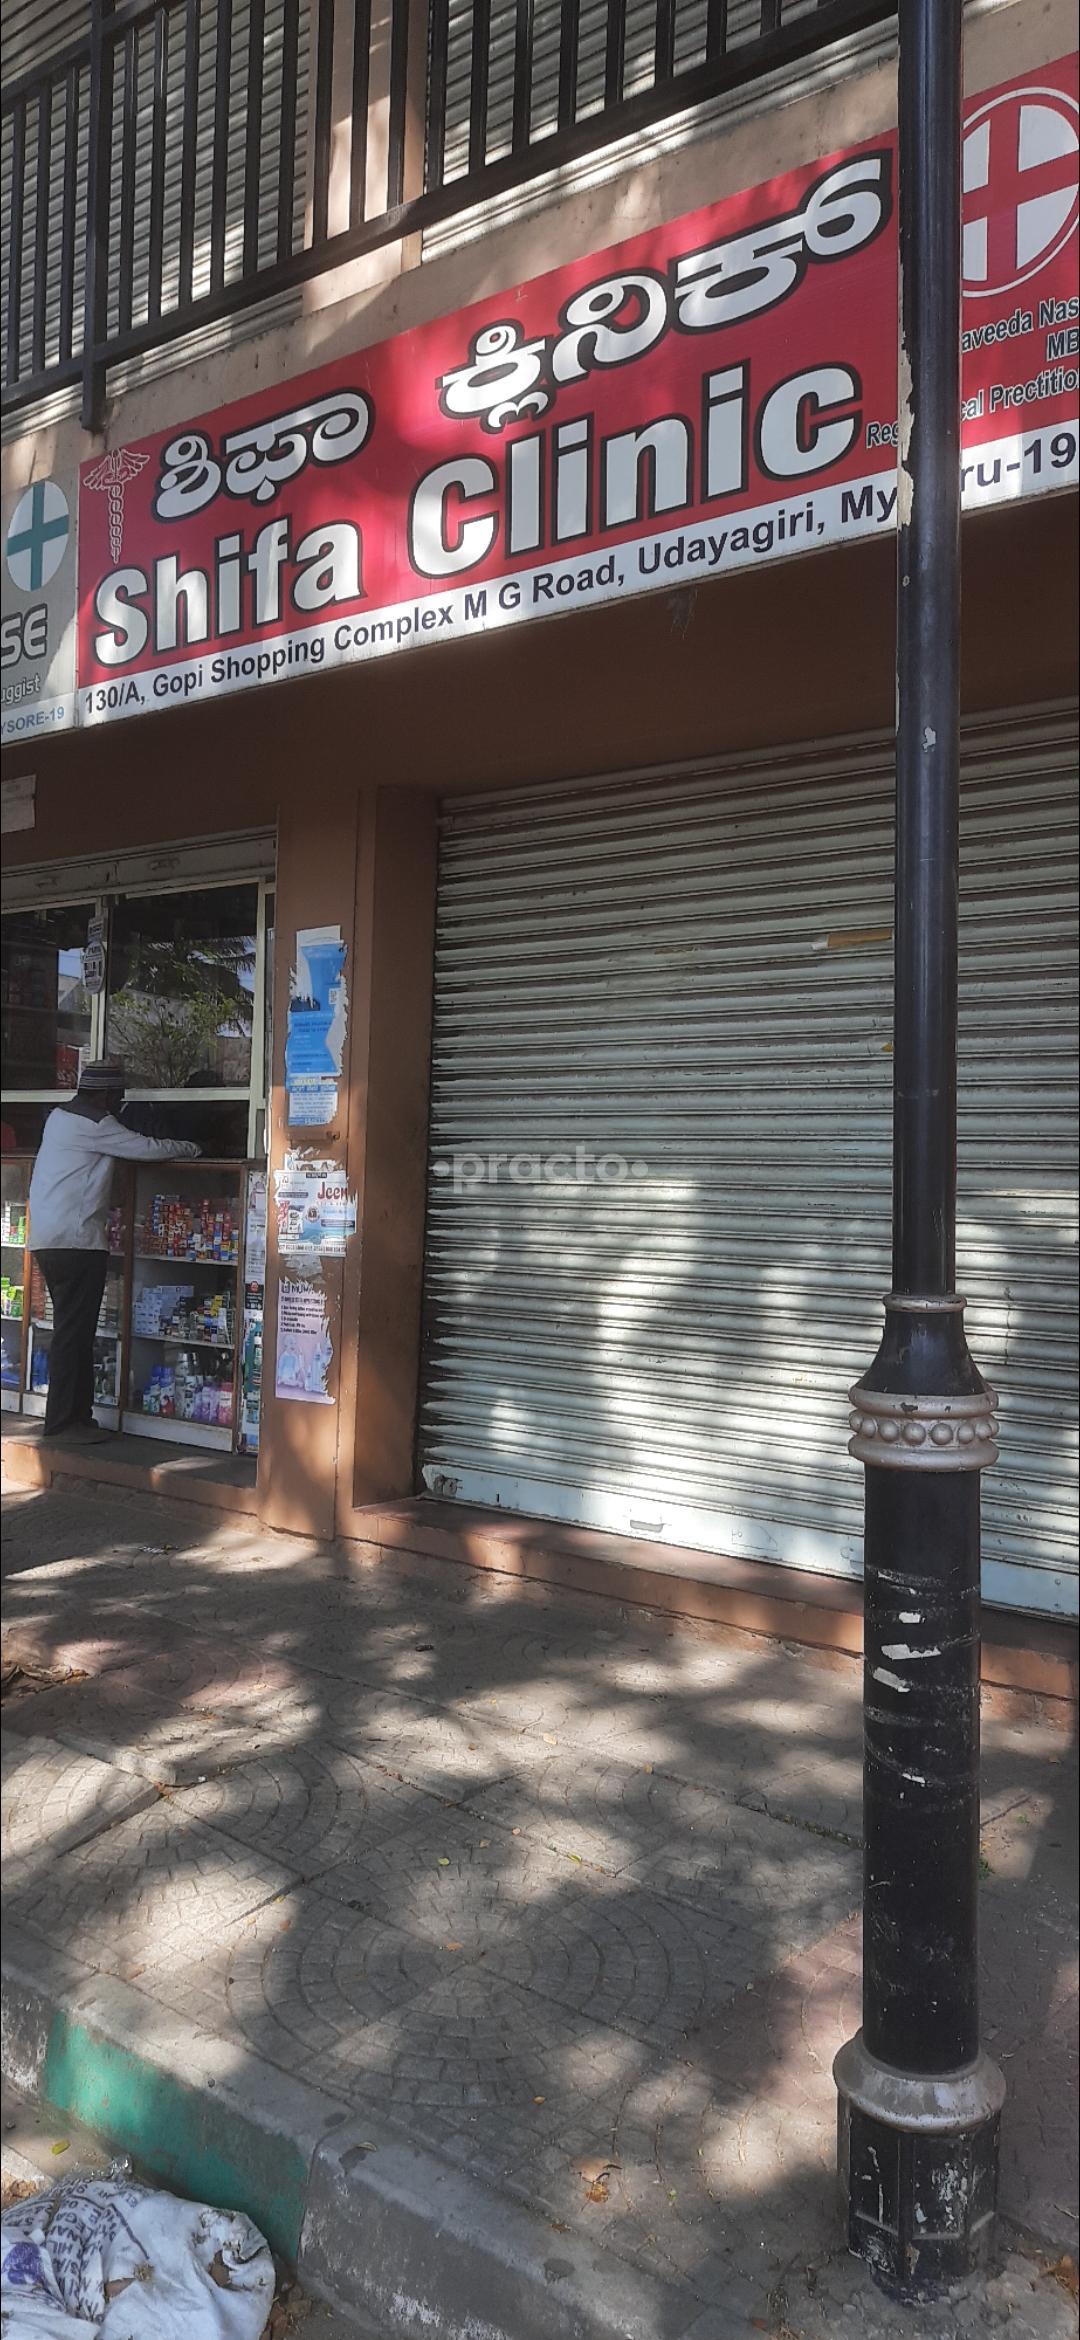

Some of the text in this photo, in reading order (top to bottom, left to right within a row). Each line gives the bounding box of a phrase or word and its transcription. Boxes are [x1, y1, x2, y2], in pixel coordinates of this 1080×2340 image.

[154, 150, 890, 521] ಶಿಫಾ ಕ್ಲಿನಿಕ್
[989, 366, 1079, 413] Prectitio
[85, 681, 146, 714] 130/A,
[153, 666, 203, 697] Gopi
[211, 639, 325, 684] Shopping
[334, 604, 453, 650] Complex
[464, 589, 487, 620] M
[499, 581, 521, 608] G
[532, 555, 625, 603] Road,
[638, 502, 825, 574] Udayagiri,
[93, 358, 861, 668] Shifa Clinic
